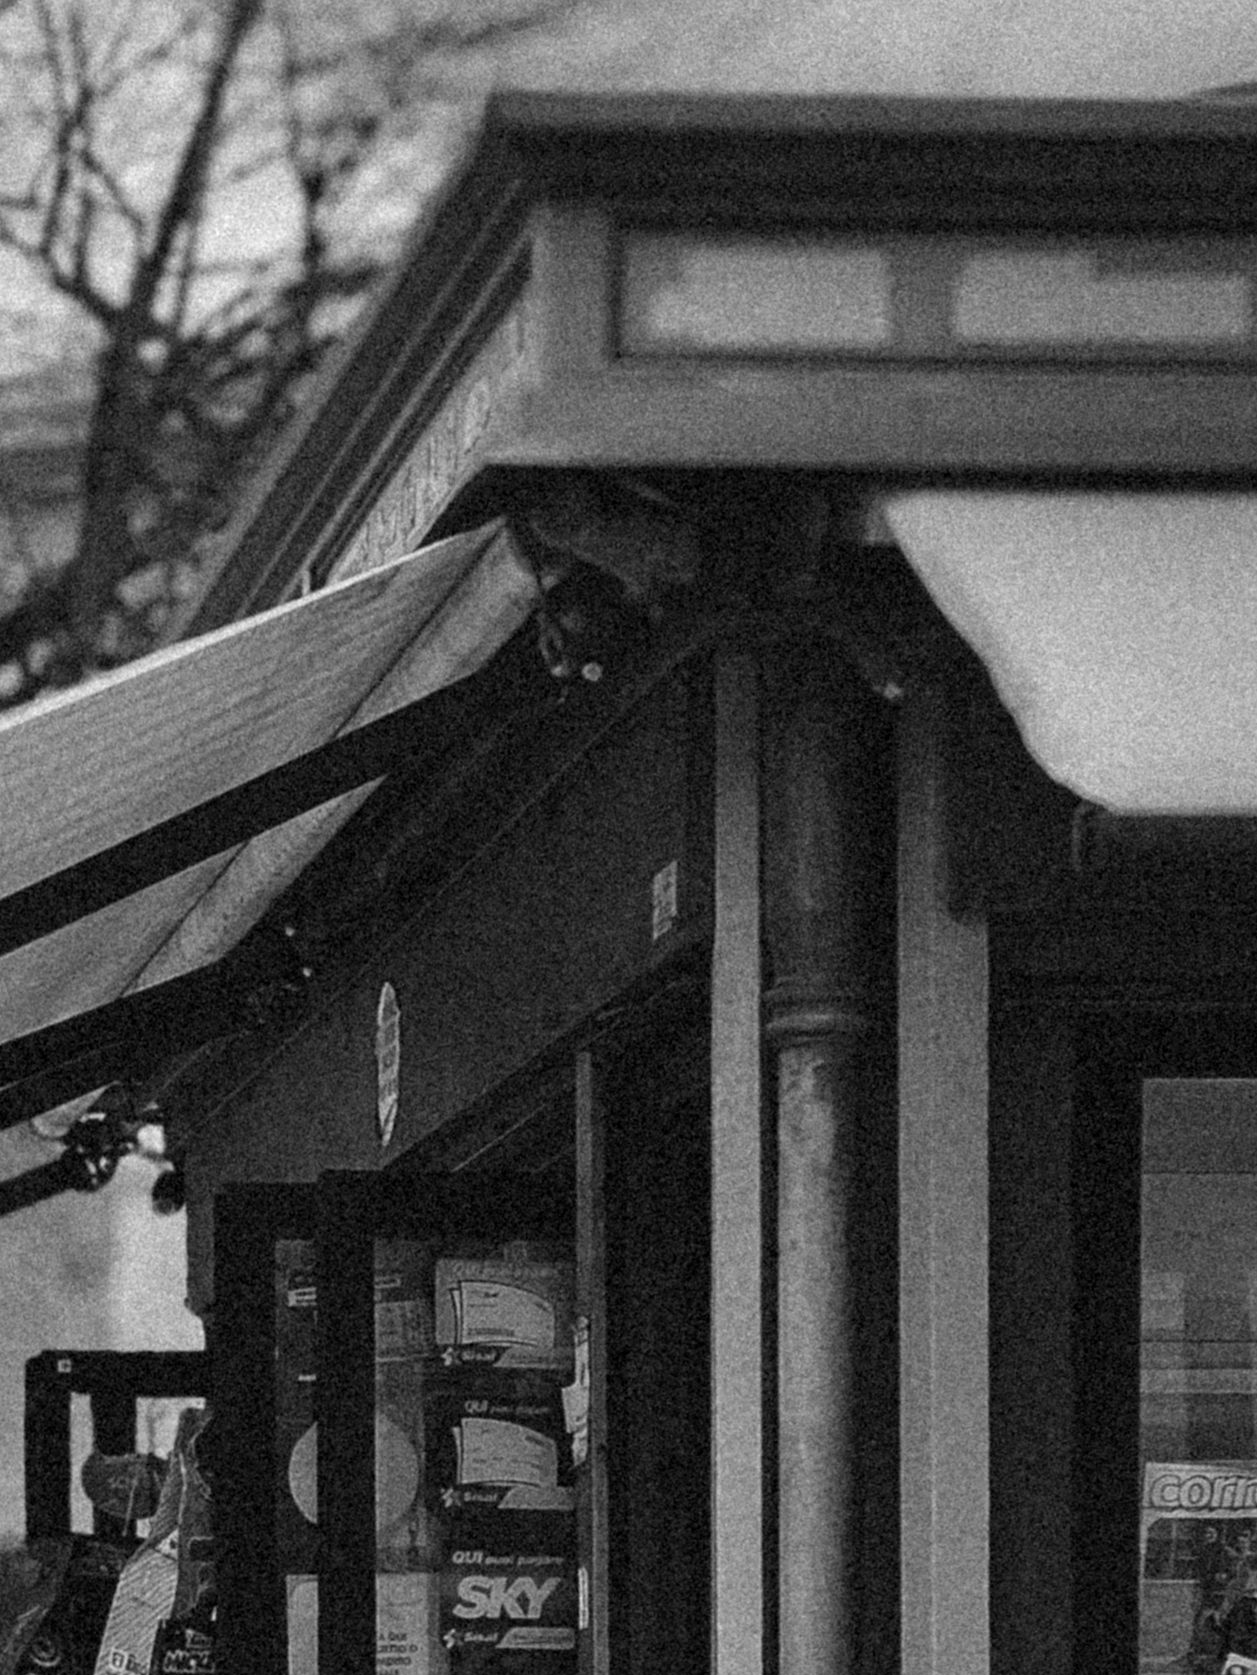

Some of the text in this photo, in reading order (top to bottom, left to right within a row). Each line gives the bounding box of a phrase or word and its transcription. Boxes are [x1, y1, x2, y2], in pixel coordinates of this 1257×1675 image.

[1150, 1475, 1257, 1509] corr
[452, 1551, 483, 1564] QUI
[452, 1575, 562, 1619] SKY
